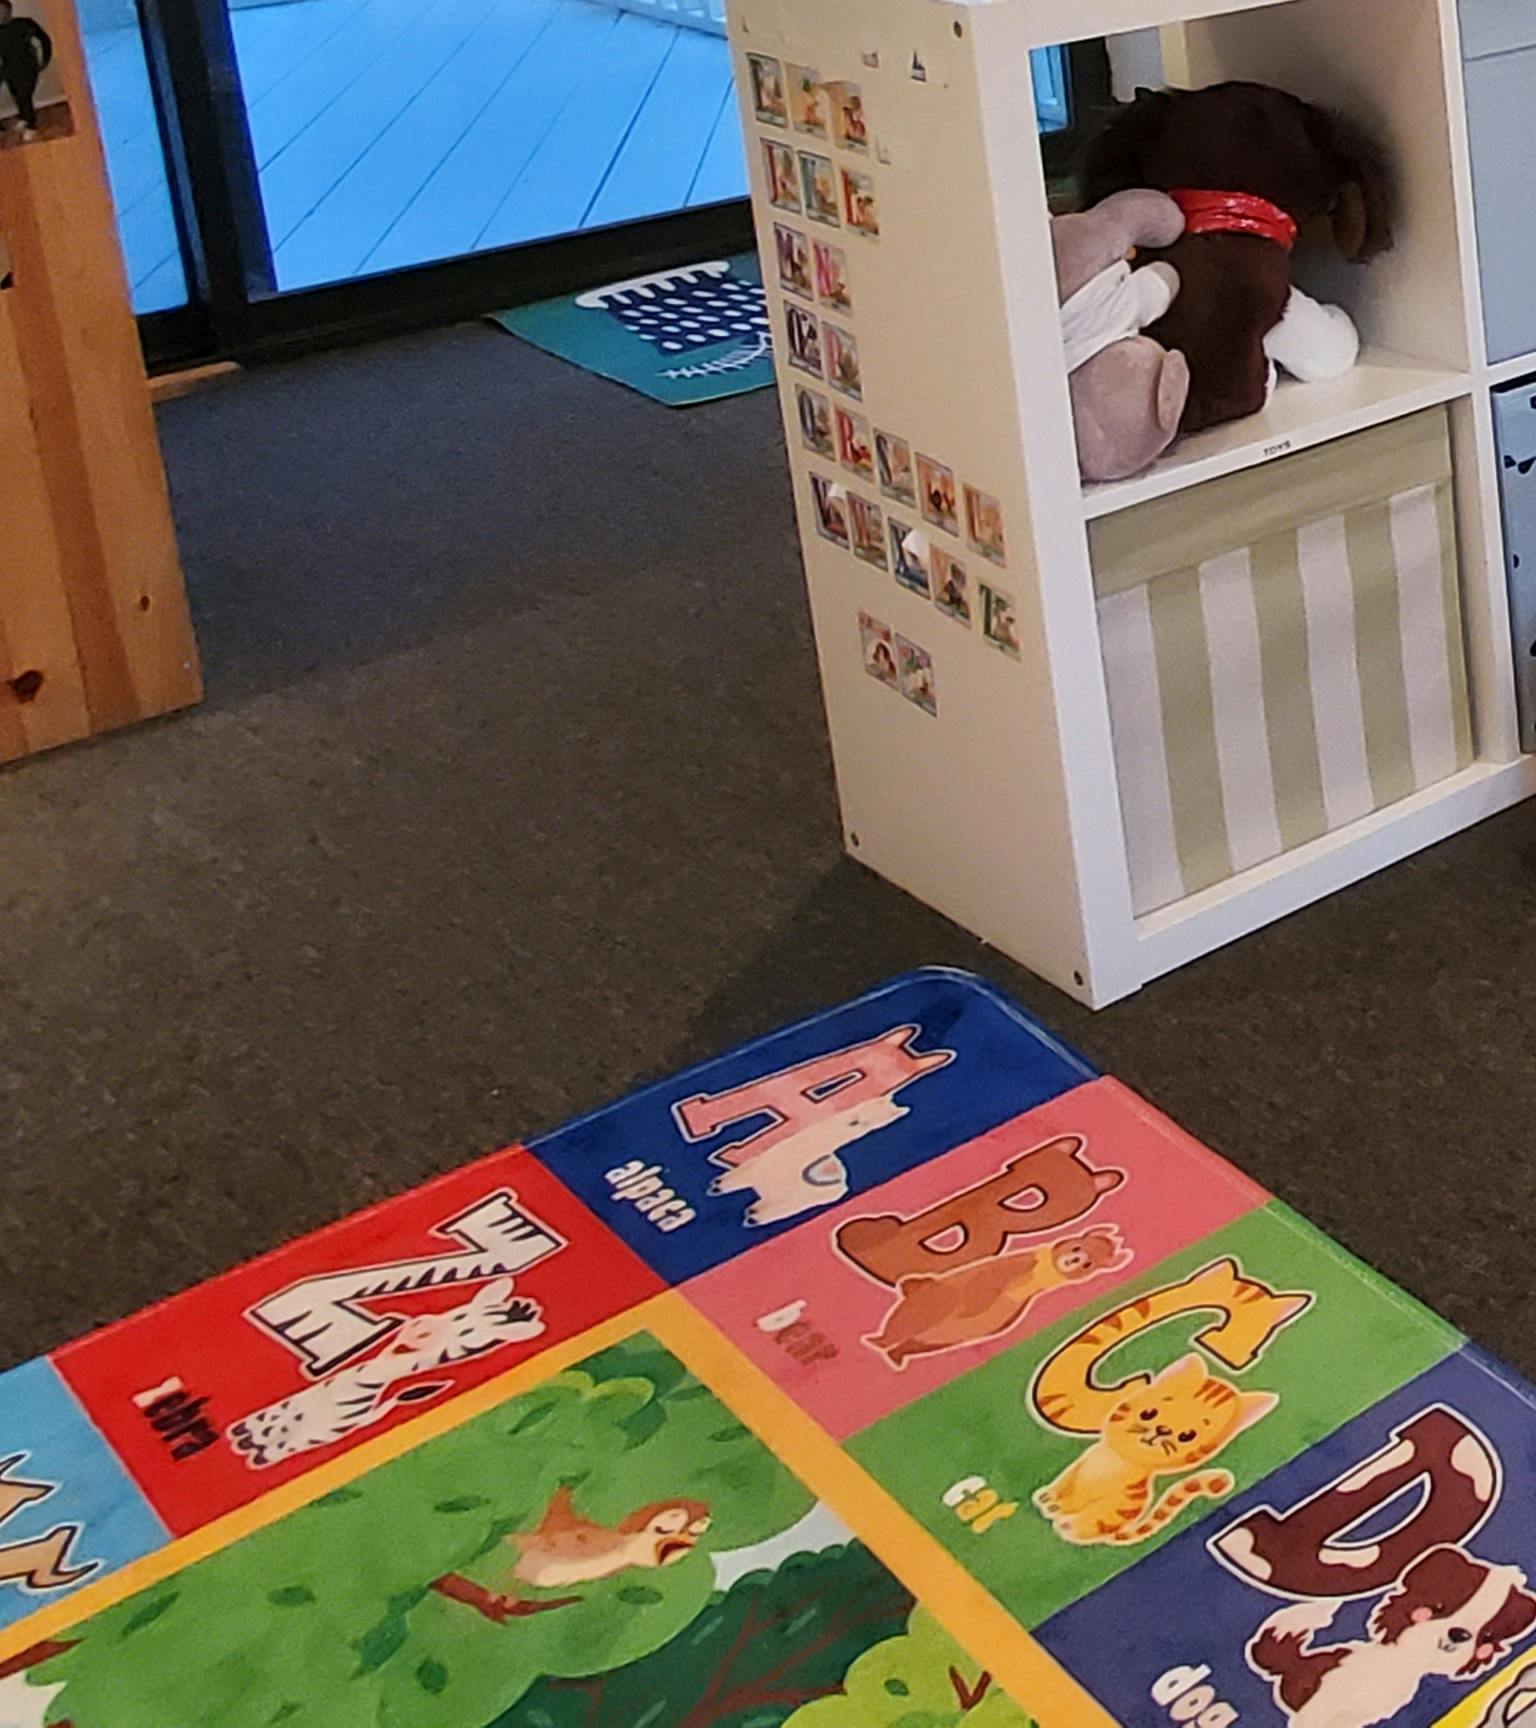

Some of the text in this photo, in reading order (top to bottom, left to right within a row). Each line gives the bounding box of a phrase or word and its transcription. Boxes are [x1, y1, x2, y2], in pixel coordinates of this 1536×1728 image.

[674, 1024, 957, 1165] A
[605, 1160, 697, 1233] alpaca
[834, 1135, 1125, 1282] B
[246, 1189, 568, 1377] Z
[755, 1298, 839, 1365] bear
[1028, 1258, 1315, 1436] C
[131, 1375, 219, 1462] zebra
[942, 1475, 1019, 1534] cat
[1208, 1403, 1502, 1598] D
